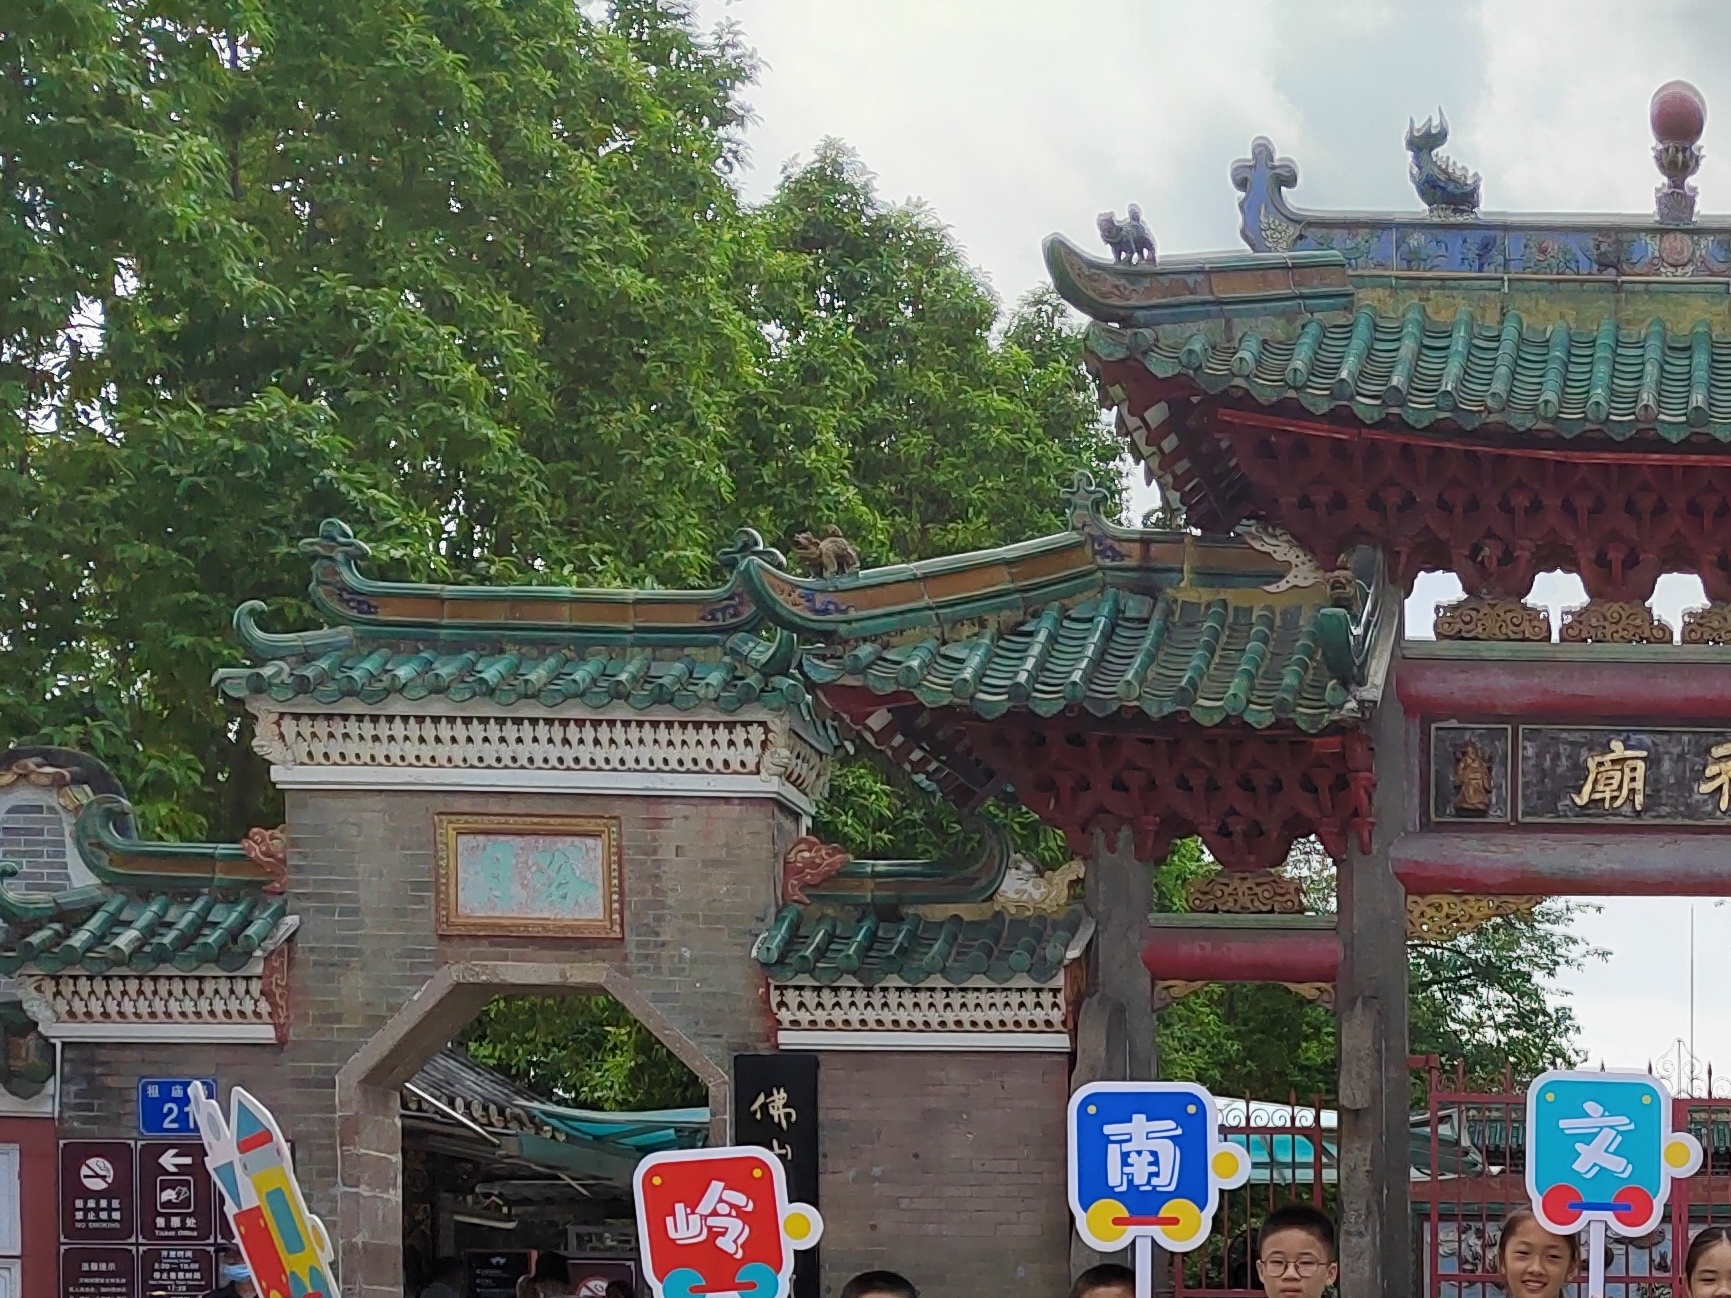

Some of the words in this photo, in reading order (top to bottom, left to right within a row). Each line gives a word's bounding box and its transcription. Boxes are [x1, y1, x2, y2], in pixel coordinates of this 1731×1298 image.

[146, 1084, 208, 1098] 祖庙
[1103, 1114, 1183, 1192] 南
[1559, 1101, 1634, 1178] 文
[665, 1180, 754, 1259] 岭
